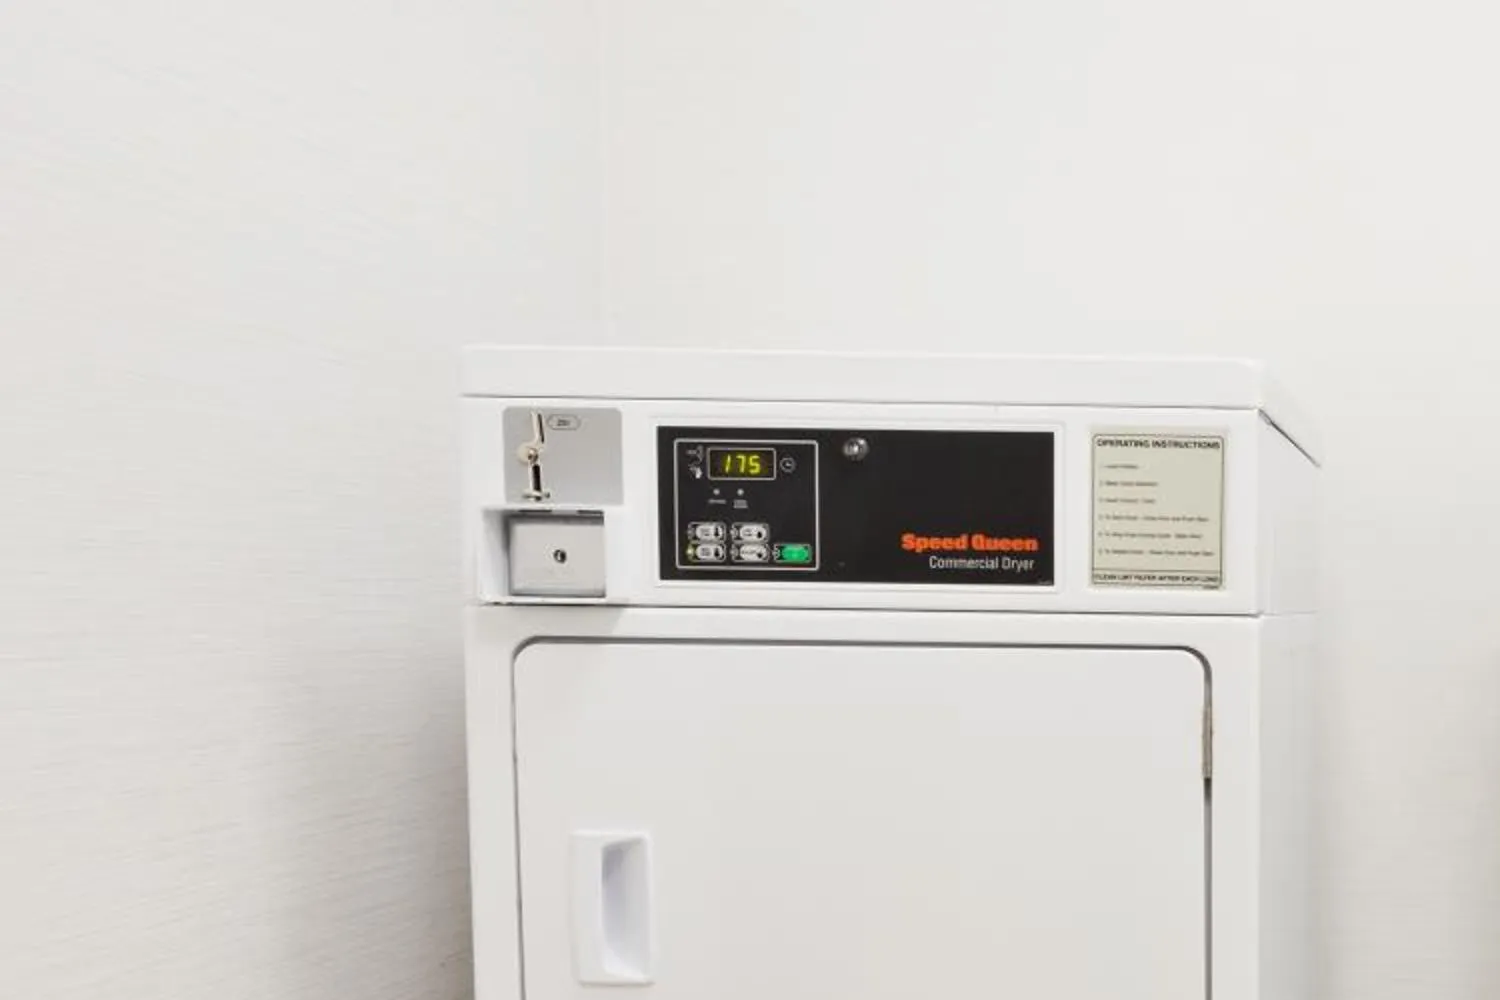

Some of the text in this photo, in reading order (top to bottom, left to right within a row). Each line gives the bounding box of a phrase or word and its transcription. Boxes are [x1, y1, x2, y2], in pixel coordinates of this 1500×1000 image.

[1097, 438, 1221, 450] OPERATING INSTRUCTIONS
[725, 453, 761, 475] 175
[901, 532, 1039, 553] Speed Queen
[928, 555, 1035, 572] Commercial Dryer
